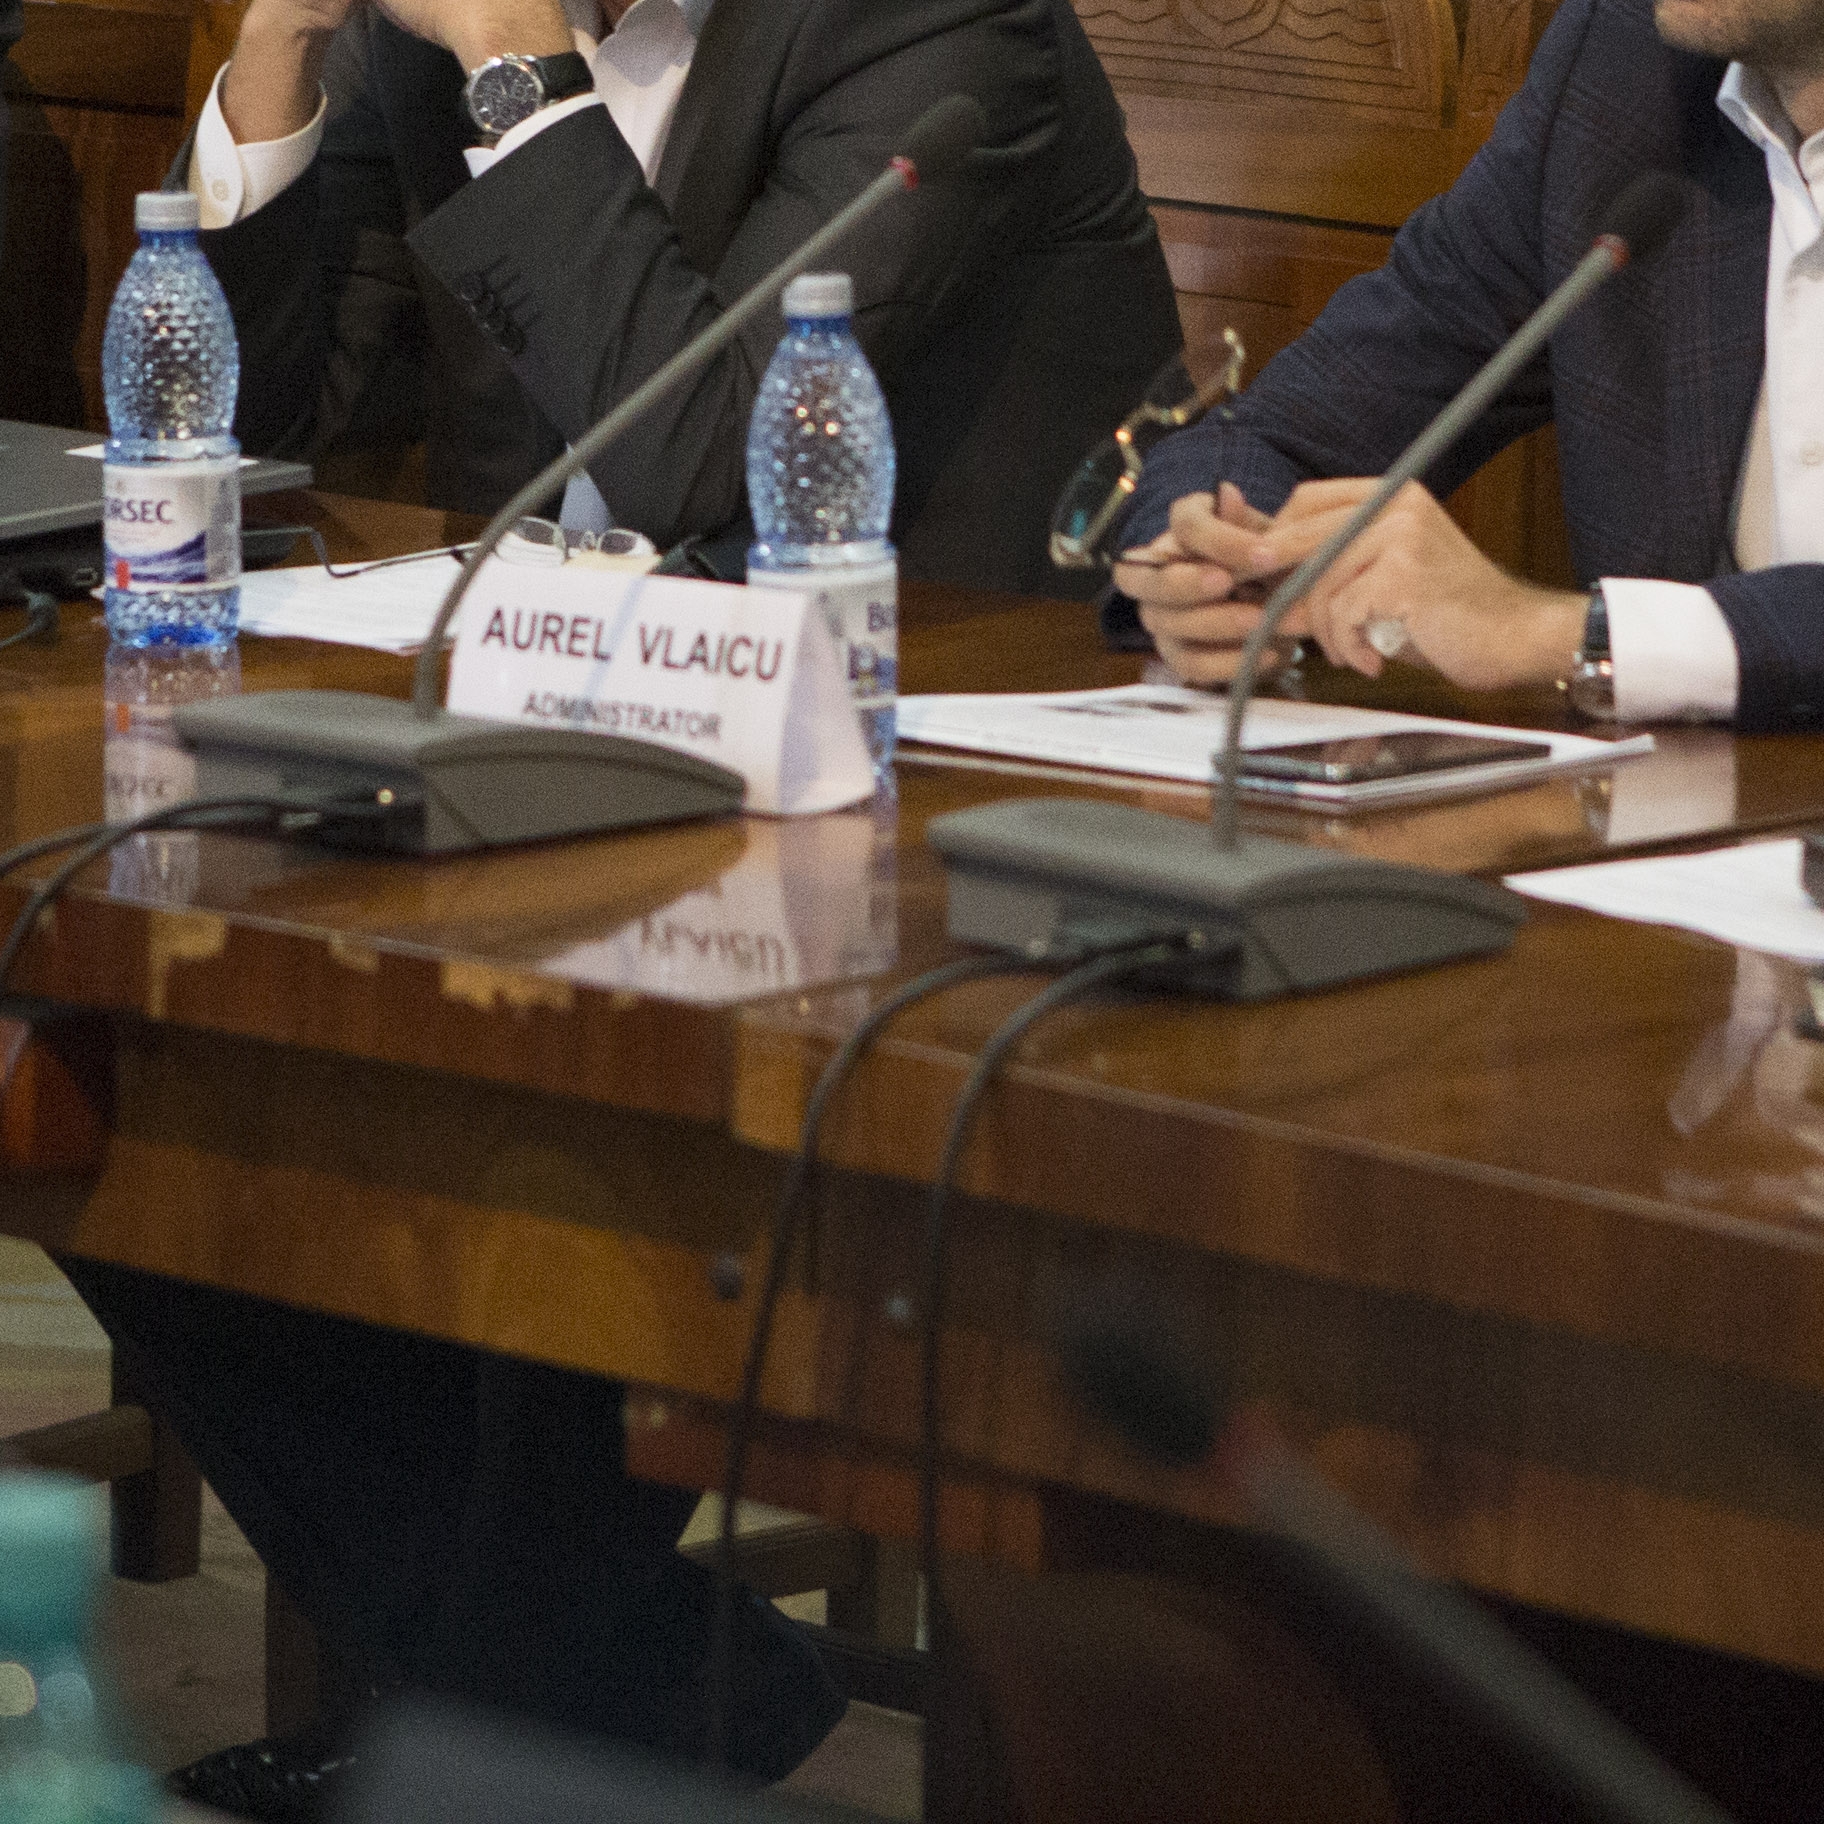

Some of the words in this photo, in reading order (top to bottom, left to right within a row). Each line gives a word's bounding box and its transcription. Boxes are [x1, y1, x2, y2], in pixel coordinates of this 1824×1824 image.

[481, 606, 613, 663] AUREL
[637, 623, 785, 682] VLAICU
[521, 690, 725, 744] ADMINISTRATOR
